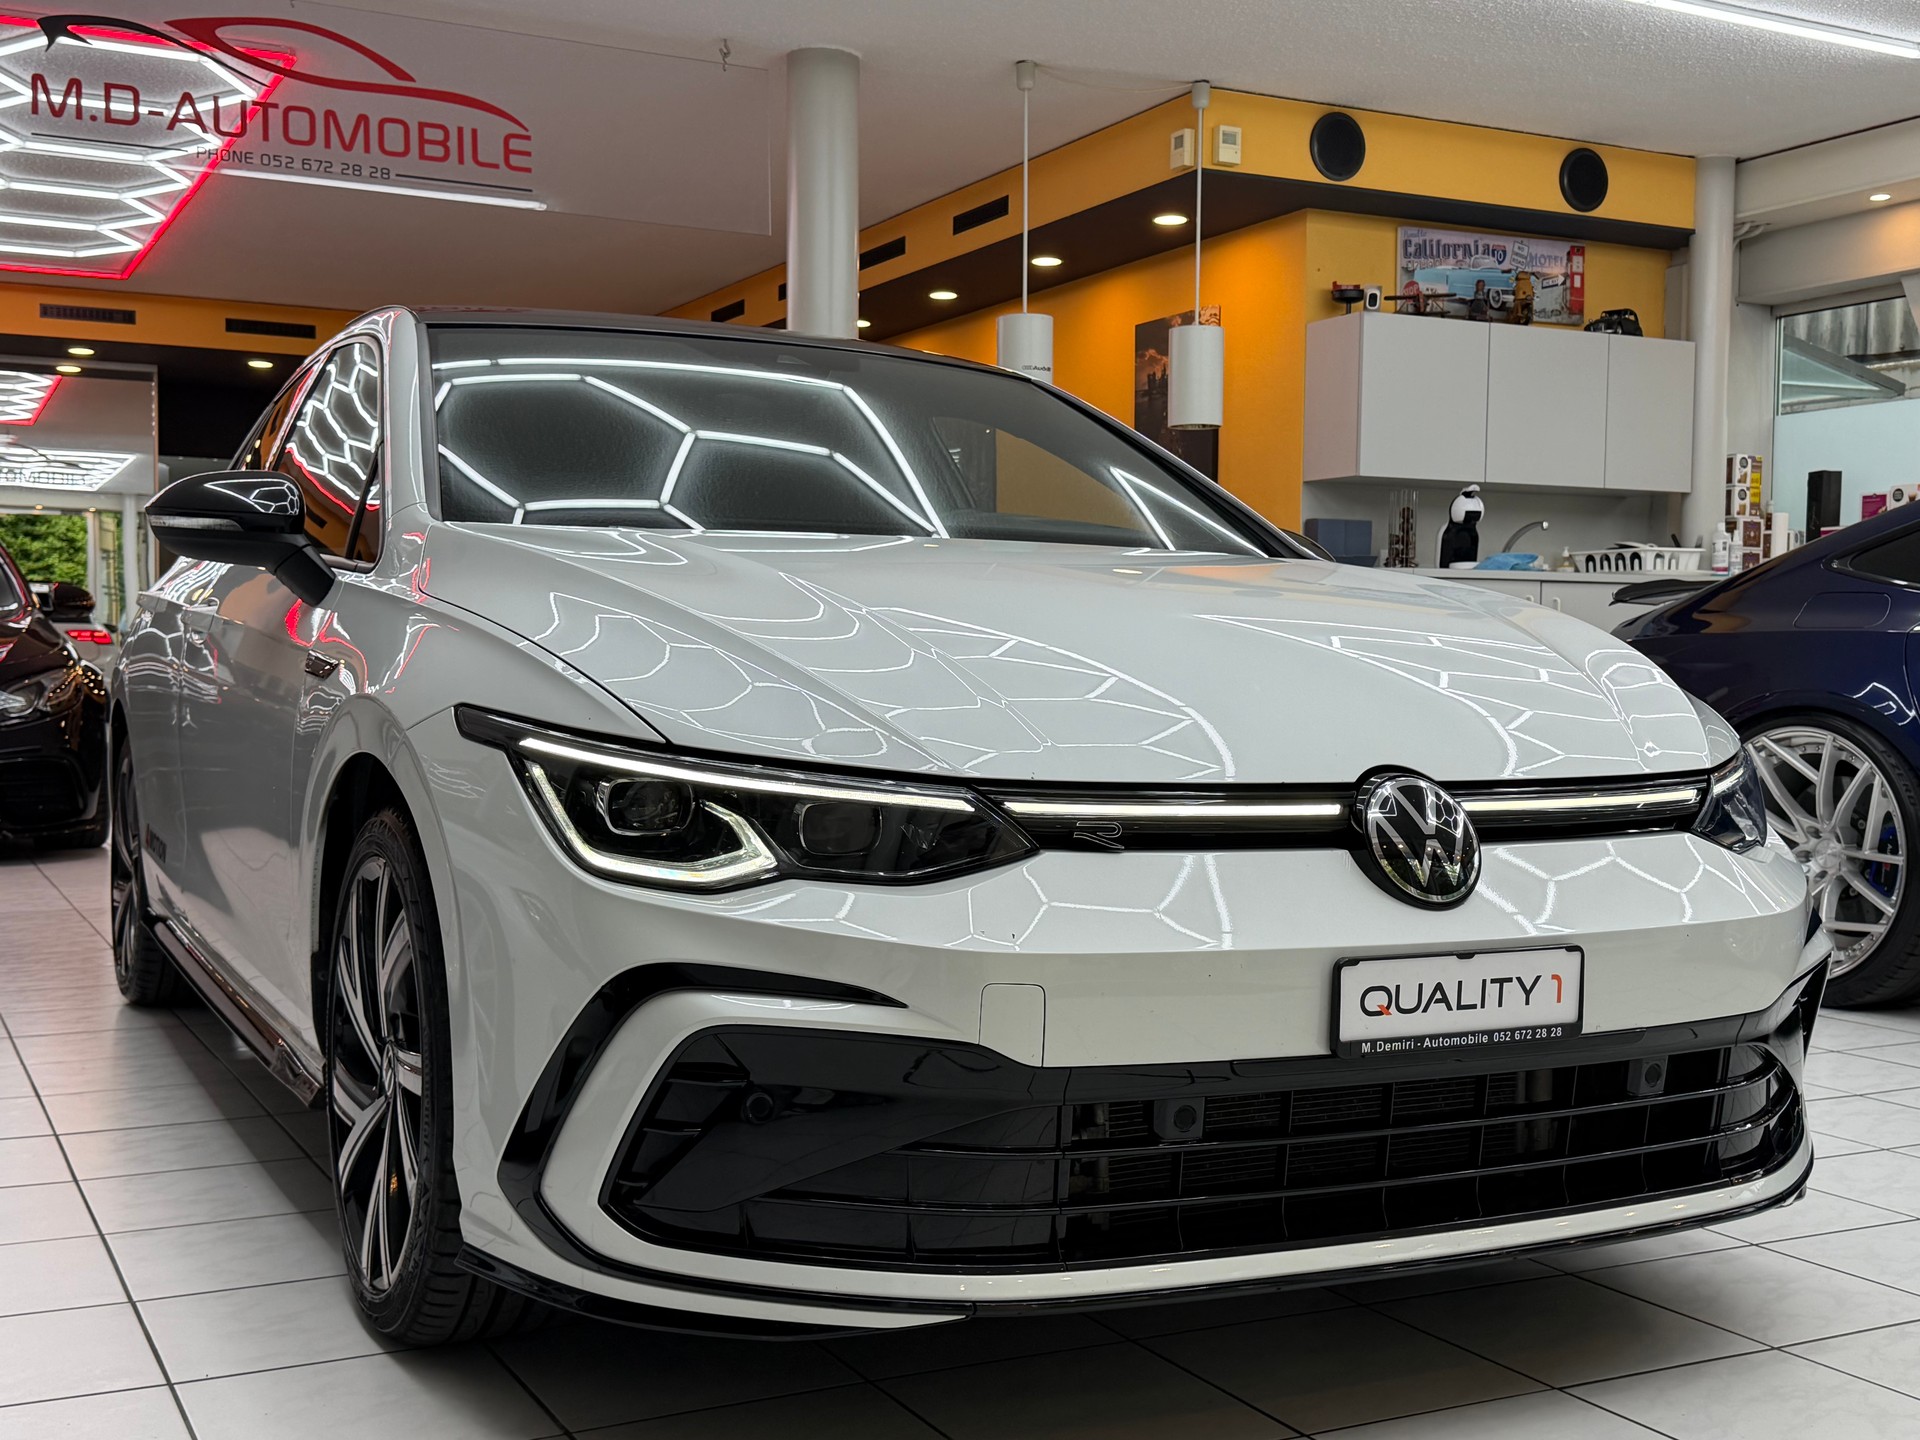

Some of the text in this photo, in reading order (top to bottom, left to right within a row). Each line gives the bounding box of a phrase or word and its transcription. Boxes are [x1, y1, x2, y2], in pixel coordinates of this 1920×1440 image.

[30, 72, 533, 173] M.D-AUTOMOBILE
[195, 146, 391, 181] PHONE 052 672 28 28
[1403, 239, 1490, 259] California
[1359, 974, 1543, 1017] QUALITY
[1423, 1033, 1489, 1048] Automobile
[1493, 1031, 1511, 1042] 052
[1514, 1029, 1532, 1041] 672
[1535, 1028, 1547, 1039] 28
[1550, 1026, 1563, 1037] 28
